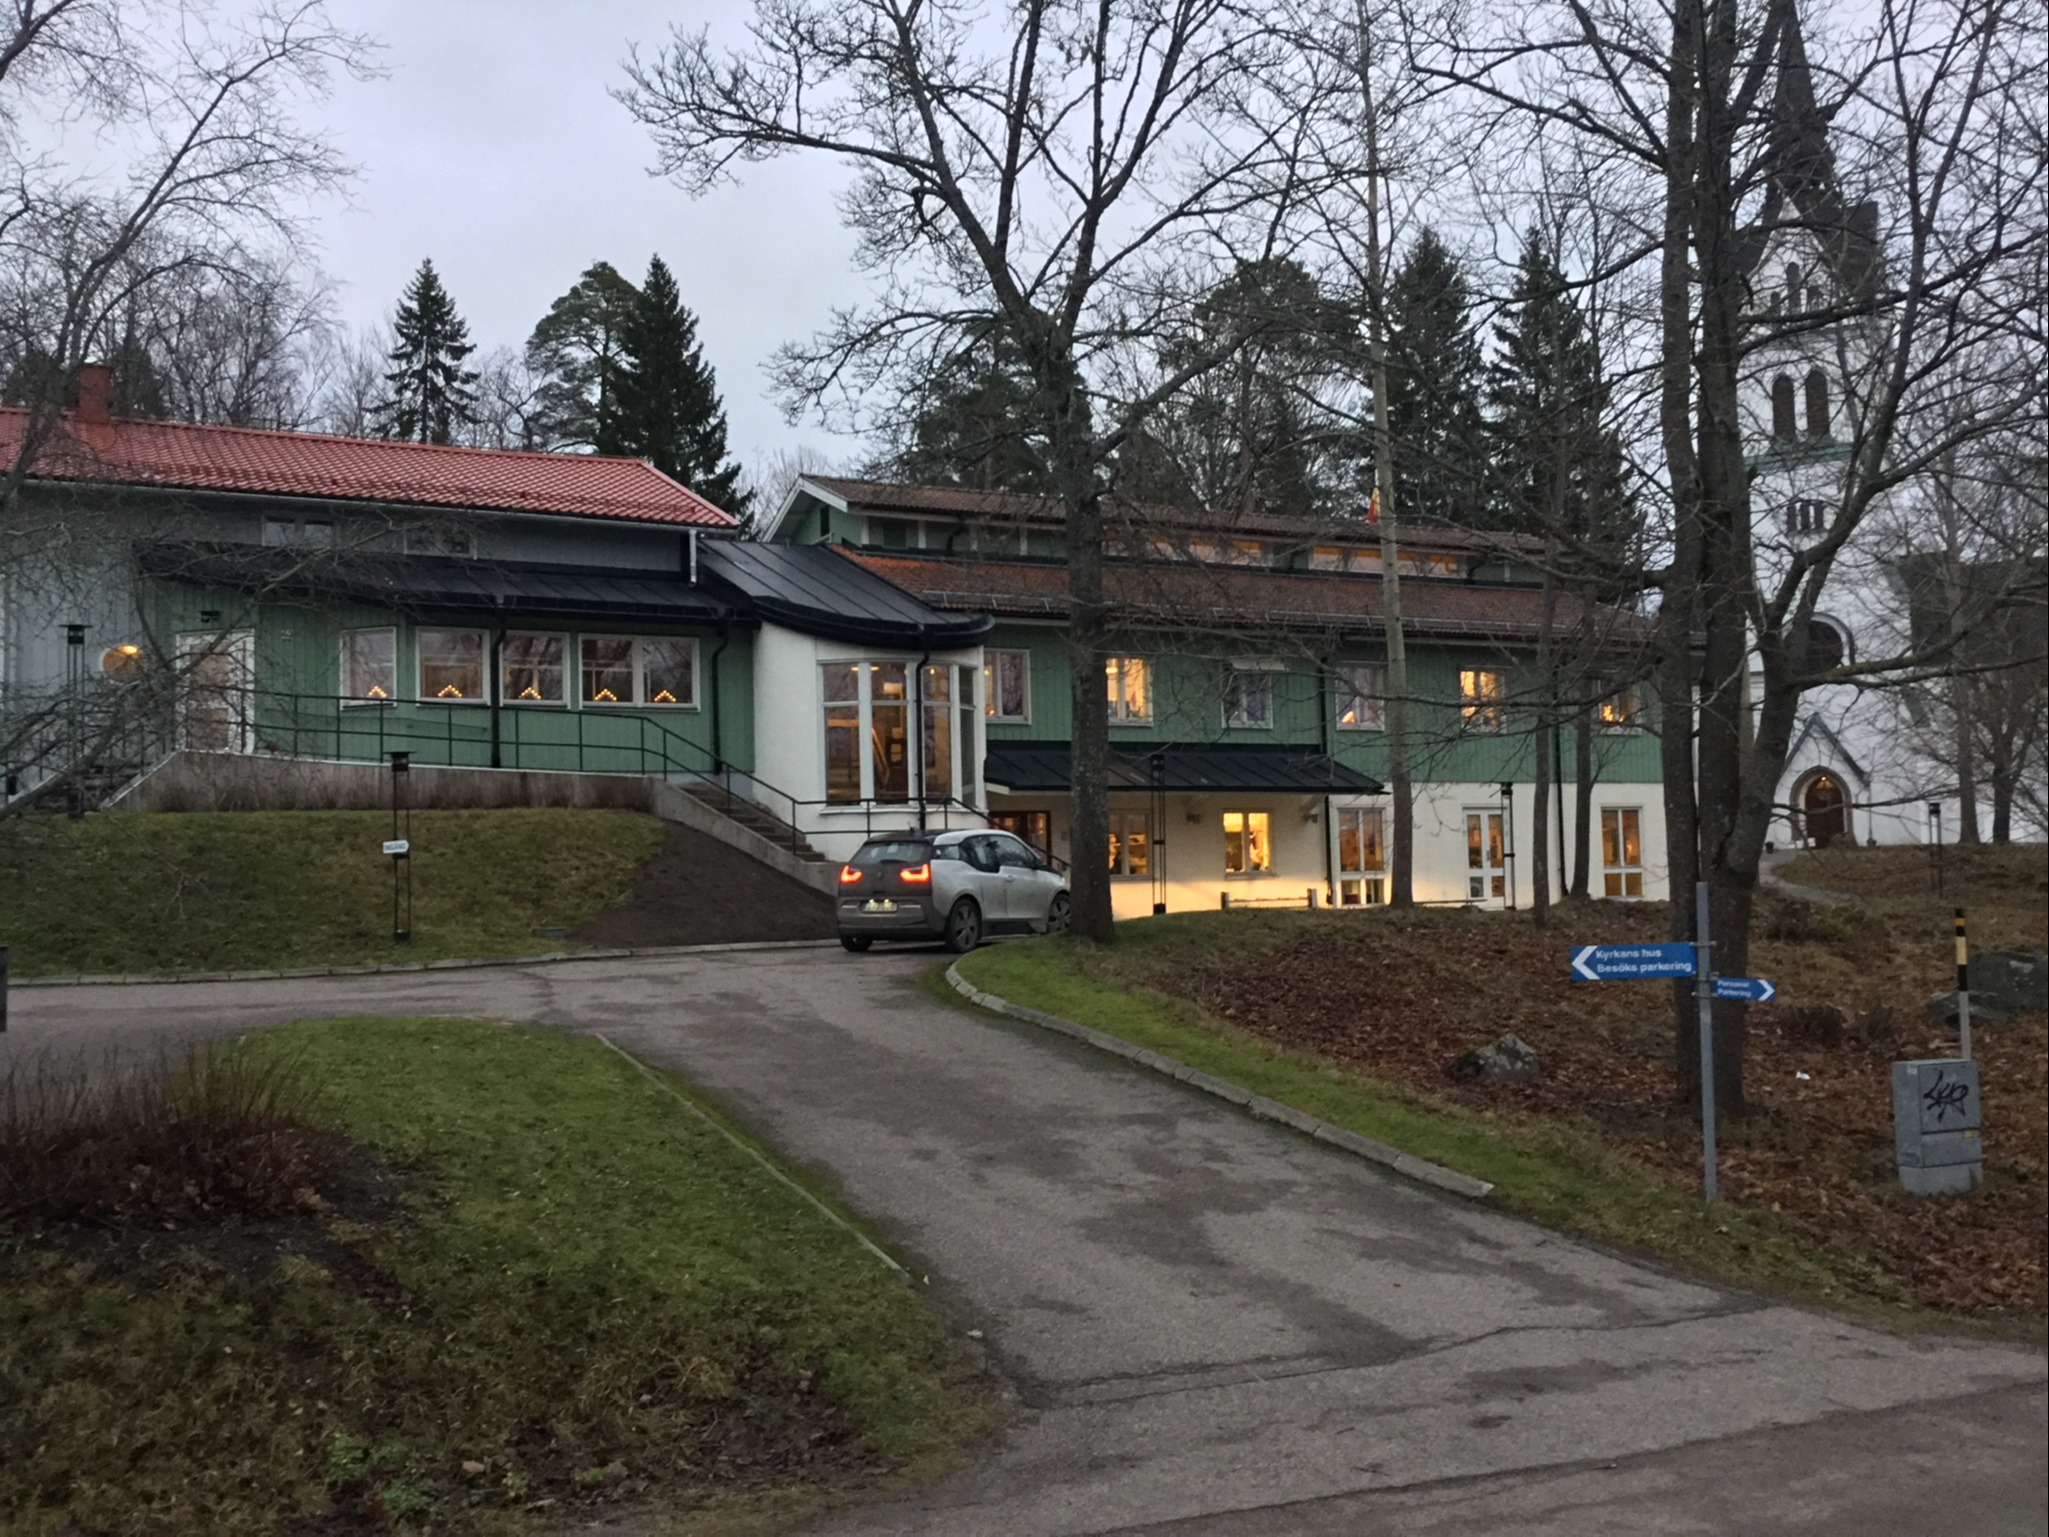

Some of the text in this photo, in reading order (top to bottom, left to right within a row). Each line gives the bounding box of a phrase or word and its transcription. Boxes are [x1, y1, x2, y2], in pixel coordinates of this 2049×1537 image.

[1596, 948, 1662, 961] Kyrkans hus
[1597, 961, 1692, 974] Besöks parkering
